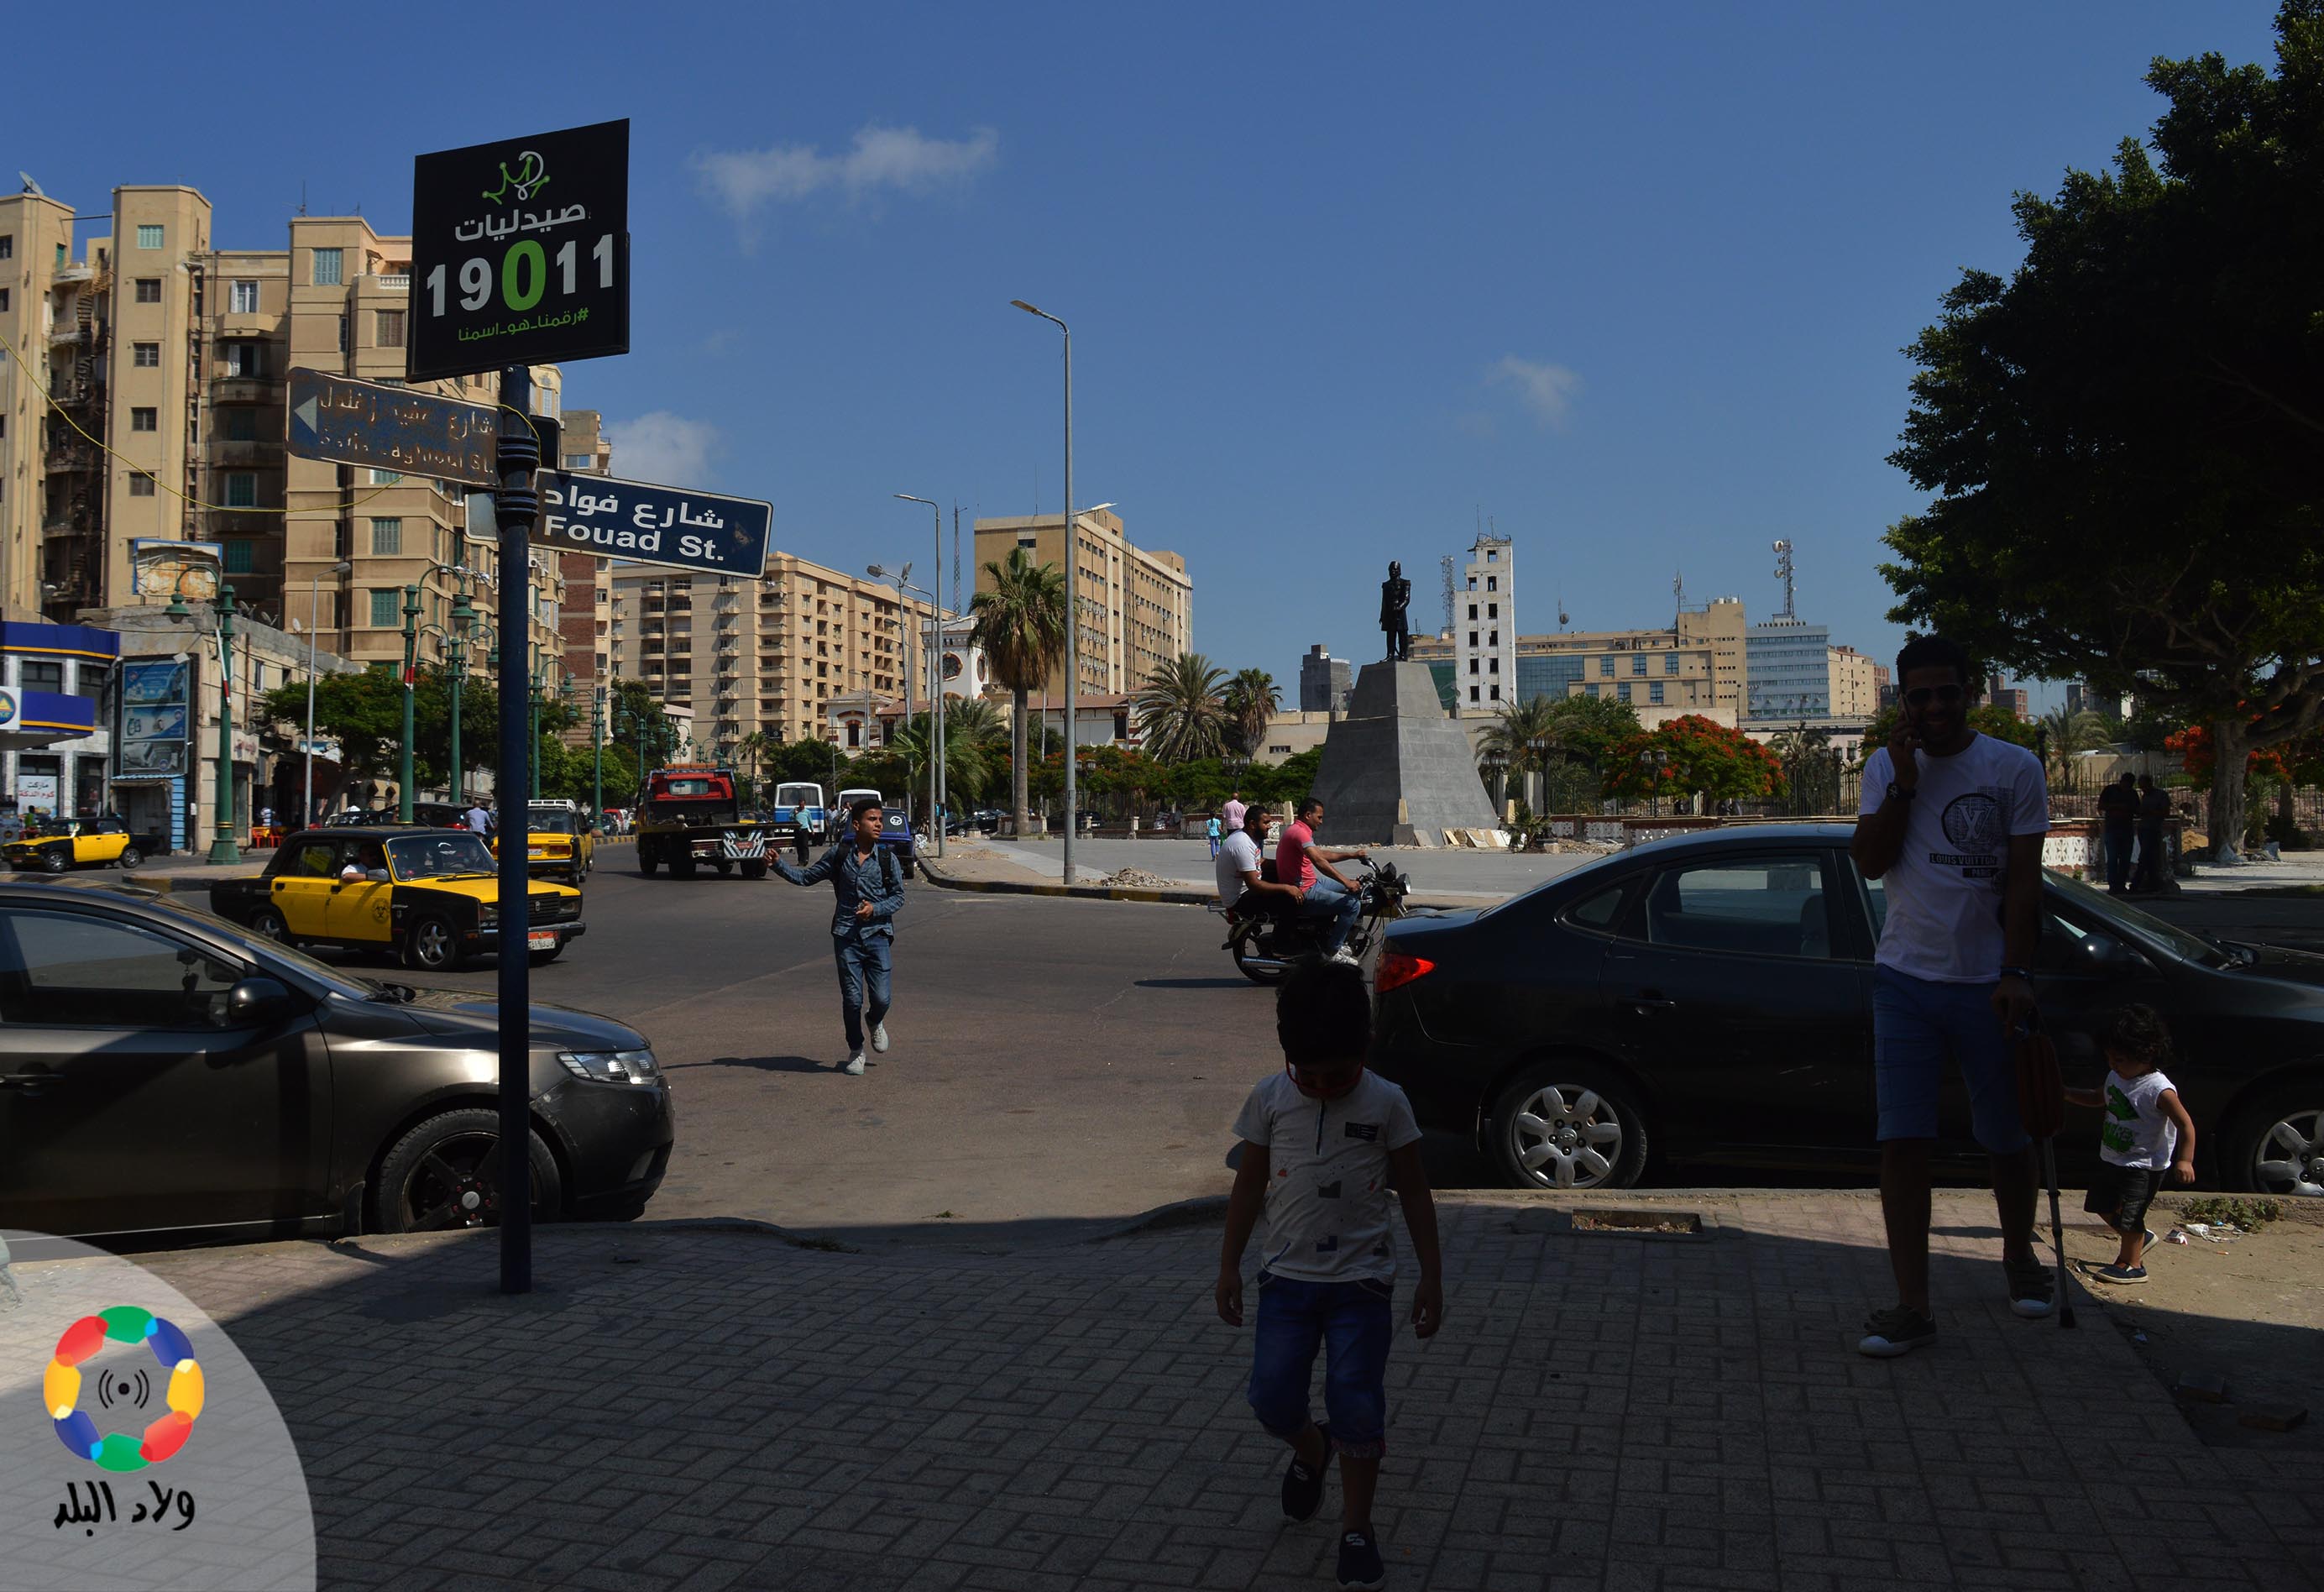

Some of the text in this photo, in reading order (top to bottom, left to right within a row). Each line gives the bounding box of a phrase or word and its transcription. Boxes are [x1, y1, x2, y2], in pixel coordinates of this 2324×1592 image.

[454, 203, 586, 242] صيدليات
[427, 233, 614, 317] 19011
[449, 411, 493, 441] شارع
[632, 501, 725, 530] شارع
[543, 515, 725, 561] Fouad St.
[1931, 854, 1995, 866] LOUIS VUITTON
